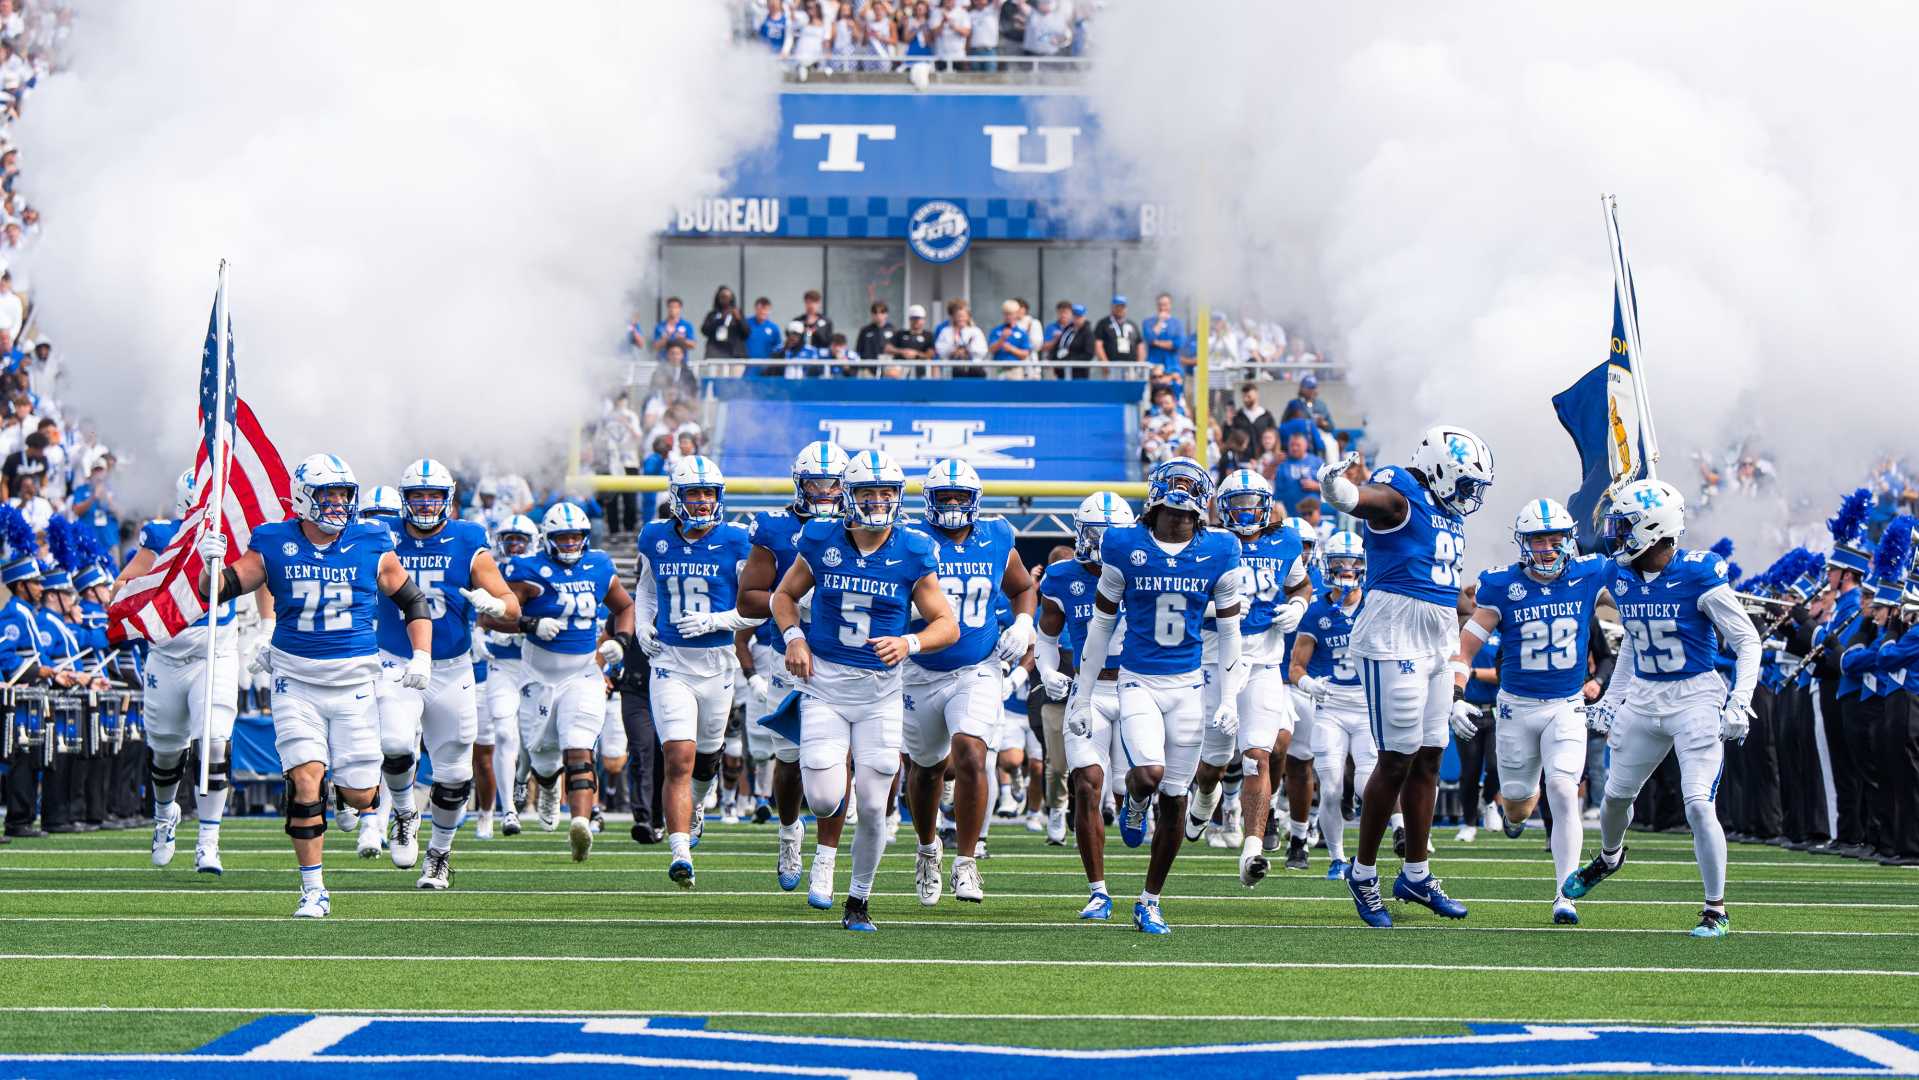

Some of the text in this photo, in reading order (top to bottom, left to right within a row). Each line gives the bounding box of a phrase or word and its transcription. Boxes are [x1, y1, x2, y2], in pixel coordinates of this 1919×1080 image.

[677, 197, 780, 233] BUREAU
[1634, 489, 1663, 510] UK
[398, 556, 452, 569] NTUCKY
[826, 549, 842, 562] SEC
[1131, 551, 1148, 565] SEC
[1240, 557, 1284, 572] NTUCKY
[284, 565, 358, 582] KENTUCKY
[659, 563, 720, 577] KENTUCKY
[938, 562, 993, 576] ENTUCKY
[824, 574, 899, 598] KENTUCKY
[1070, 582, 1086, 595] SEC
[1135, 576, 1209, 592] KENTUCKY
[292, 580, 353, 631] 72
[666, 576, 711, 624] 16
[556, 592, 598, 630] 79
[838, 592, 873, 648] 5
[1154, 593, 1187, 647] 6
[1514, 601, 1583, 623] KENTUCKY
[1520, 617, 1579, 671] 29
[1624, 619, 1687, 674] 25
